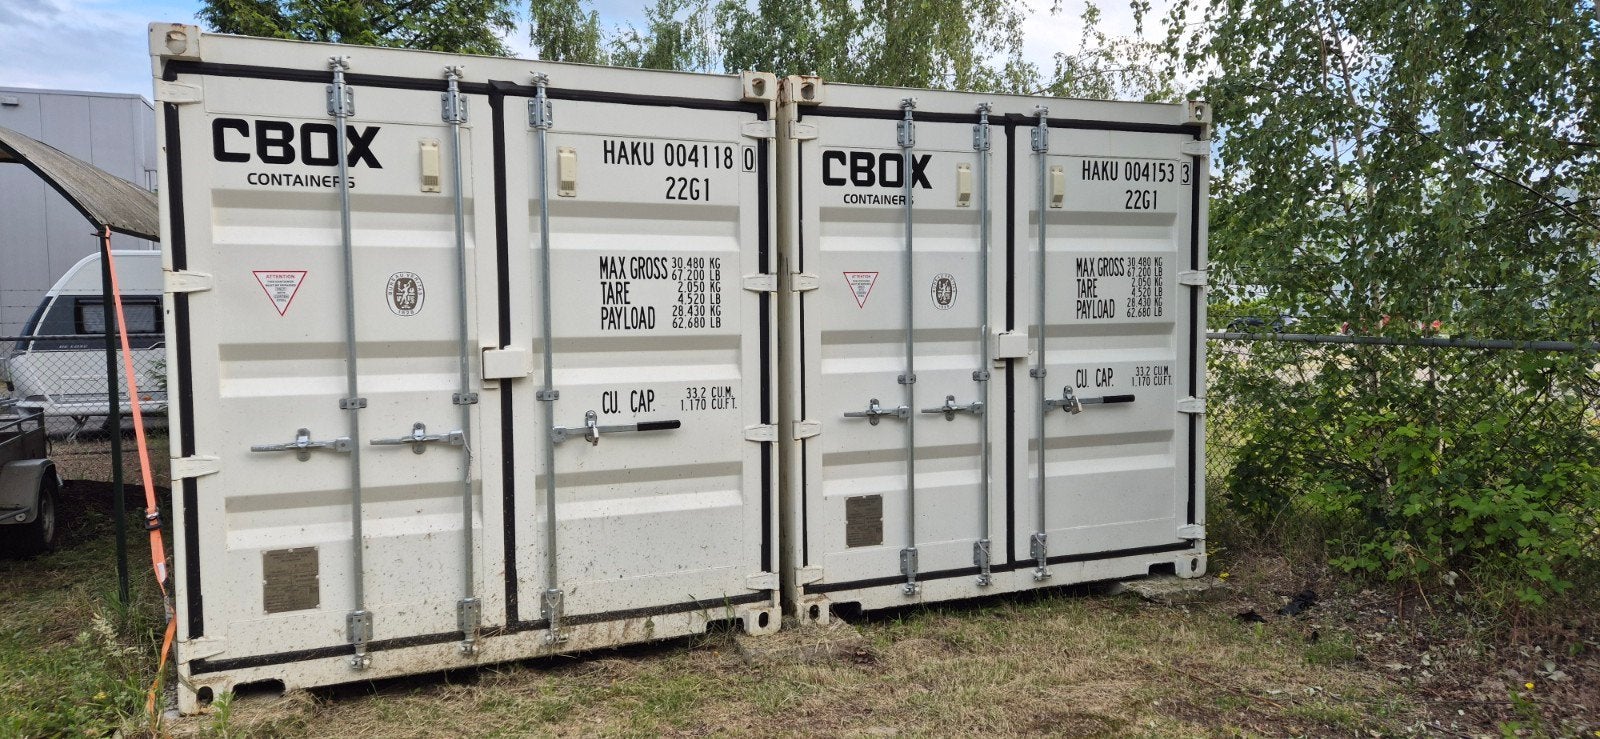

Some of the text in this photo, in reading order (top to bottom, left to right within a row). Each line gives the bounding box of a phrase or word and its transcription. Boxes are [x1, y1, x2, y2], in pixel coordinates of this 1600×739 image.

[212, 118, 383, 168] CBOX
[603, 140, 754, 170] HAKU 004118 0
[822, 150, 932, 189] CBOX
[1082, 160, 1190, 184] HAKU 004153 3
[666, 176, 710, 202] 22G1
[844, 194, 914, 205] CONTAINER
[1125, 190, 1157, 210] 22G1
[672, 258, 721, 268] 30.480 KG
[1127, 256, 1163, 266] 30.480 KG
[600, 256, 668, 280] MAX GROSS
[1076, 258, 1125, 278] MAX GROSS
[1127, 267, 1163, 278] 67.200 LB
[672, 270, 721, 281] 67.200 LB
[678, 282, 721, 292] 2.050 KG
[1077, 278, 1098, 298] TARE
[1132, 278, 1163, 288] 2.050 KG
[601, 281, 630, 305] TARE
[1132, 287, 1163, 298] 4.520 LB
[678, 294, 721, 304] 4.520 LB
[1127, 298, 1163, 308] 28.430 KG
[672, 305, 722, 316] 28.430 KG
[1076, 299, 1115, 320] PAYLOAD
[1127, 307, 1163, 318] 62.680 LB
[601, 306, 656, 330] PAYLOAD
[672, 317, 722, 328] 62.680 LB
[1136, 366, 1151, 376] 33.2
[1076, 368, 1114, 388] CU. CAP.
[1132, 377, 1151, 387] 1.170
[686, 387, 706, 398] 33.2
[602, 390, 656, 414] CU. CAP.
[680, 399, 706, 411] 1.170
